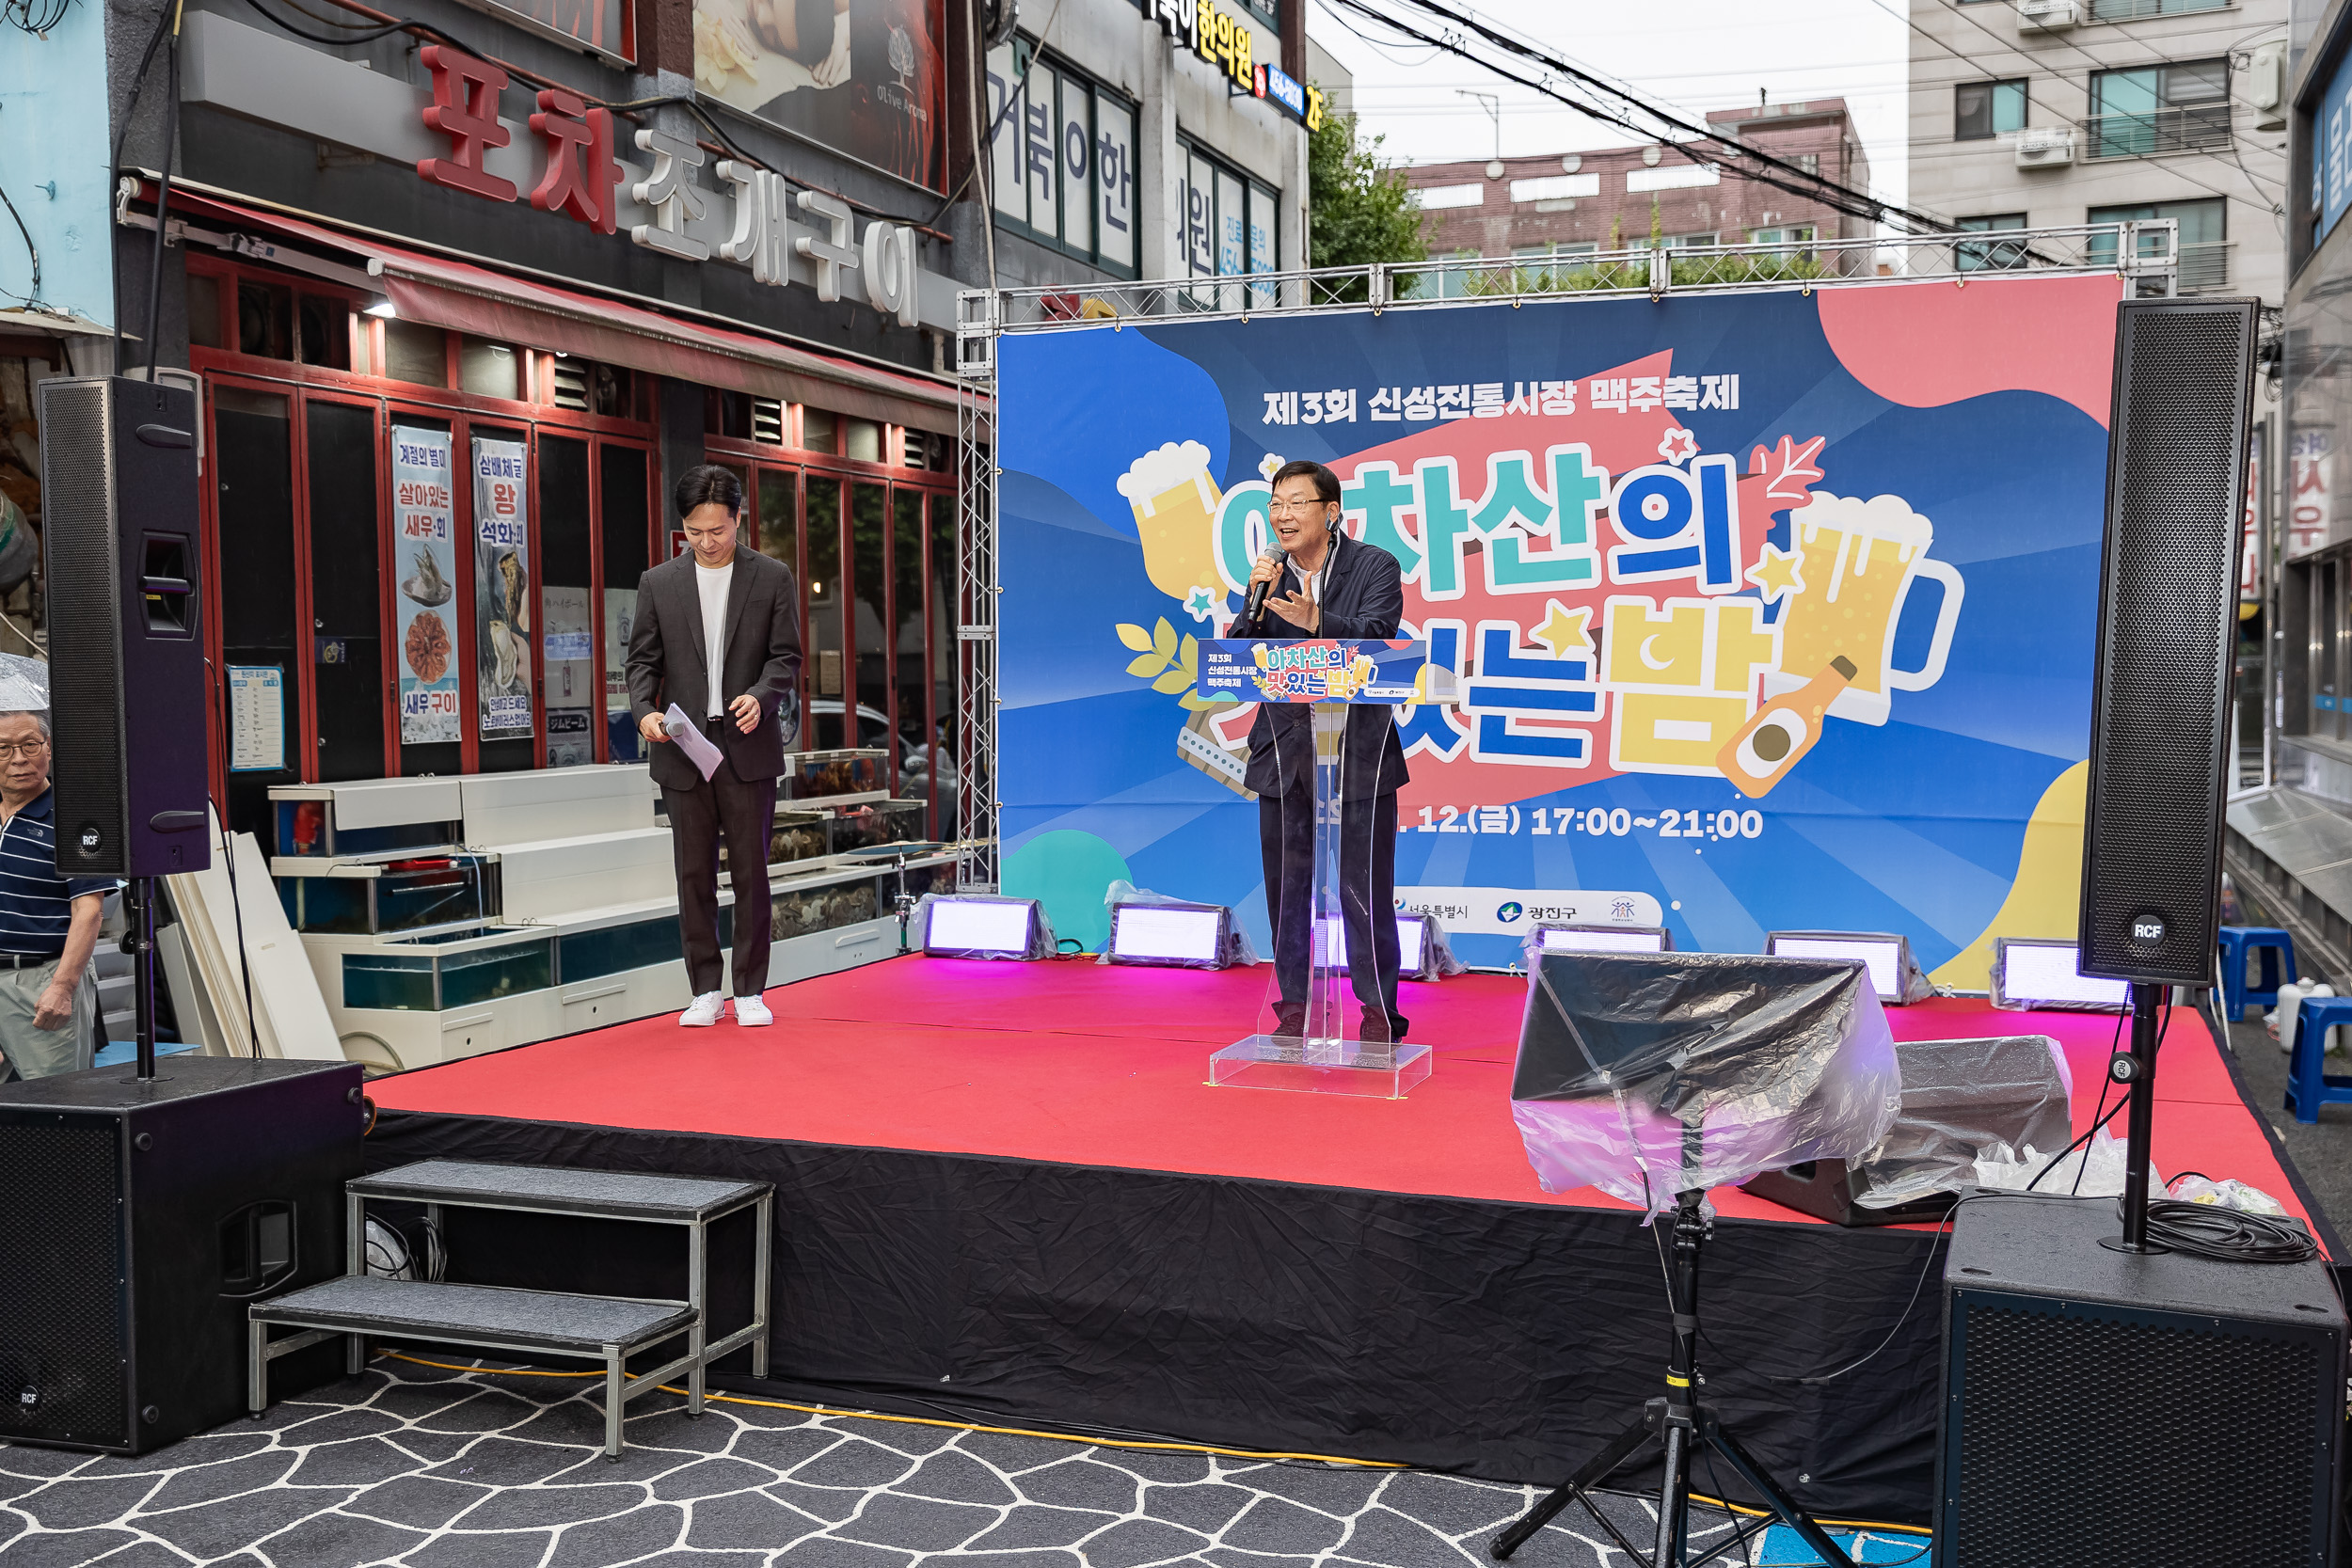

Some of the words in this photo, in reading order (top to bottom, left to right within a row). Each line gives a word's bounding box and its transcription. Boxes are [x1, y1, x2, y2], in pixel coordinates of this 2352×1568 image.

[1307, 86, 1324, 133] 2F
[630, 129, 919, 327] 조개구이
[1227, 216, 1243, 245] 진료
[1250, 225, 1266, 256] 문의
[1263, 388, 1357, 425] 제3회
[1367, 381, 1576, 421] 신성전통시장
[1590, 373, 1739, 412] 맥주축제
[400, 445, 428, 467] 계절의
[429, 448, 446, 468] 별미
[480, 455, 522, 478] 삼배체굴
[399, 483, 449, 509] 살아있는
[494, 483, 516, 515] 왕
[1207, 654, 1232, 663] 제3회
[1267, 645, 1347, 671] 아차산의
[1207, 666, 1258, 675] 신성전통시장
[1207, 678, 1242, 688] 맥주축제
[550, 718, 585, 730] ジムビーム
[1418, 804, 1521, 836] 12.(금)
[1531, 807, 1764, 839] 17:00~21:00
[83, 835, 98, 846] RCF
[1528, 906, 1578, 920] 광진구
[2134, 924, 2162, 939] RCF
[2118, 1062, 2126, 1077] RCF
[22, 1393, 37, 1404] RCF
